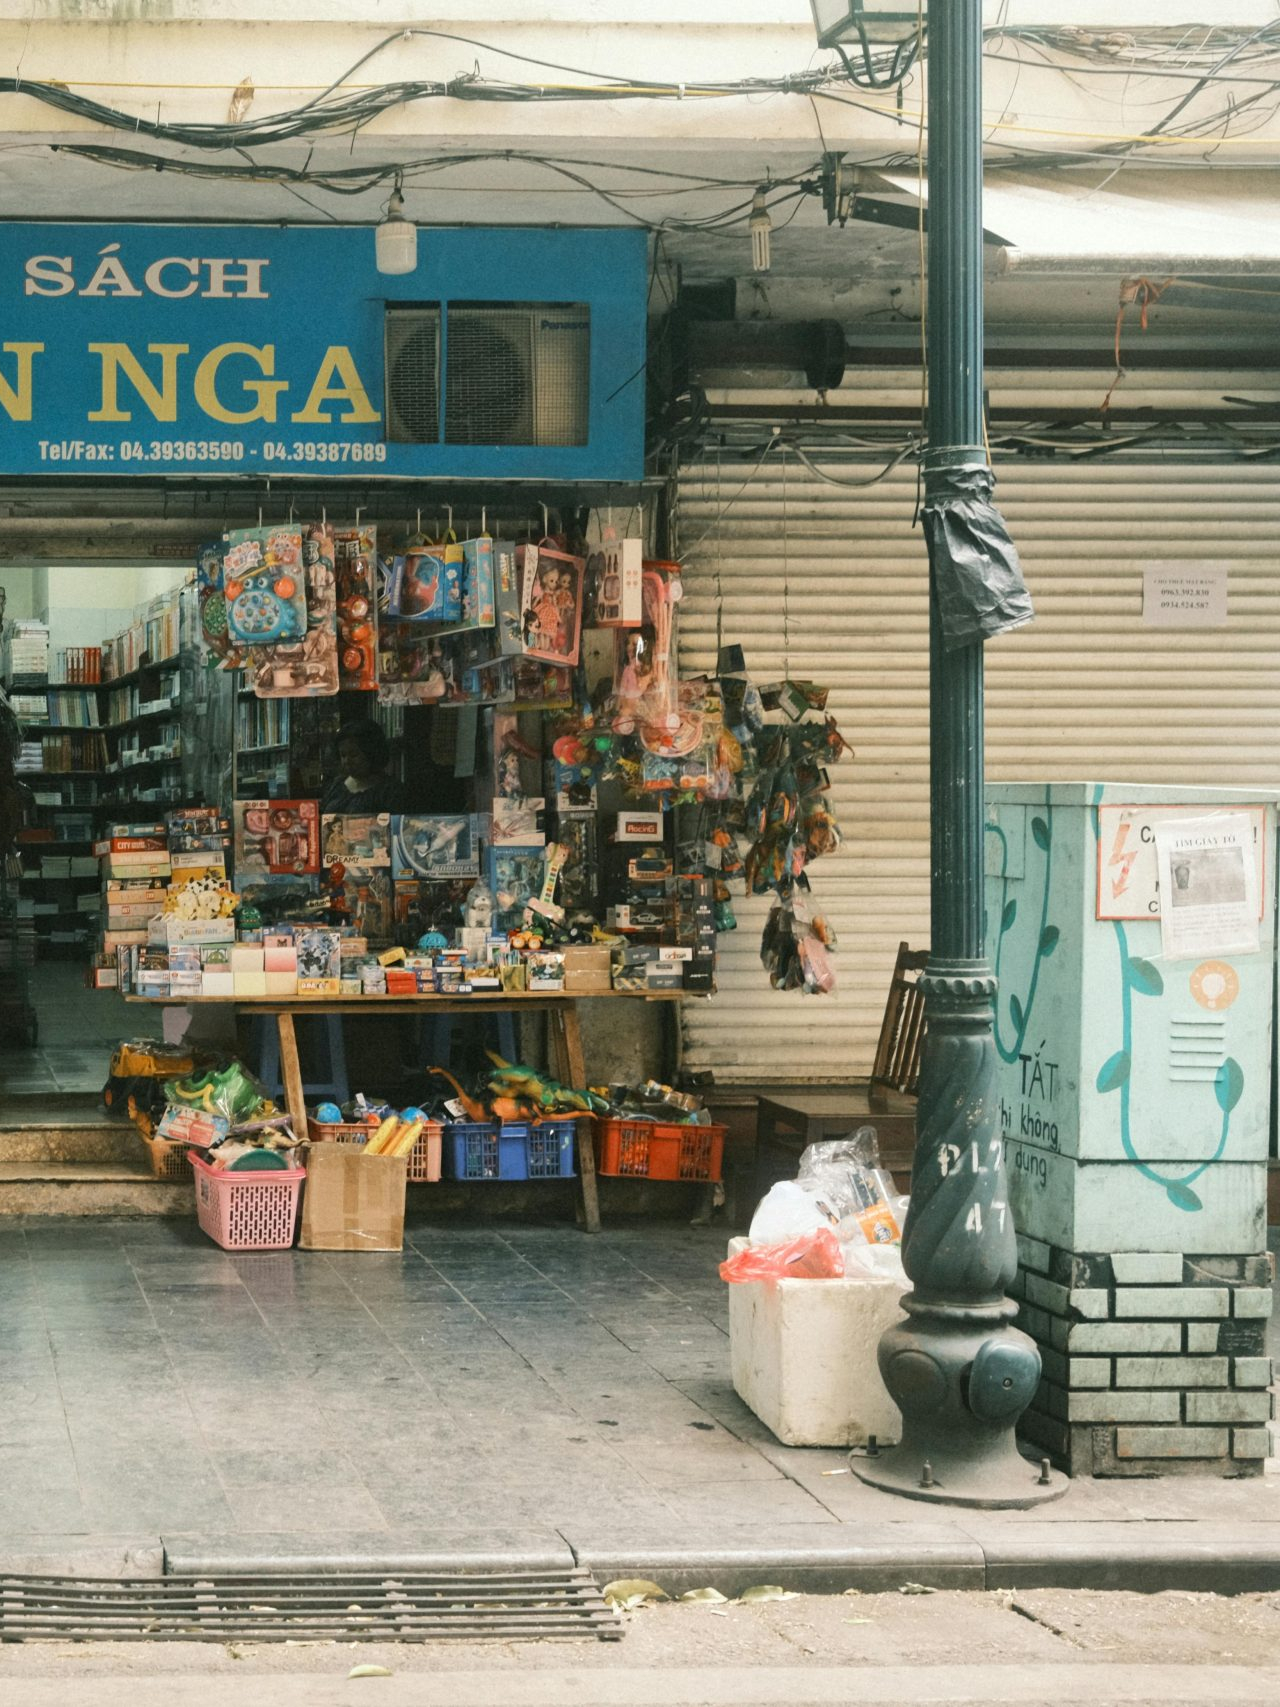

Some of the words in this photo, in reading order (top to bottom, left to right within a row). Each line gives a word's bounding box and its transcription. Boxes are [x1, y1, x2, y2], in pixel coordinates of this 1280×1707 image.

[24, 242, 270, 299] SÁCH
[87, 341, 382, 425] NGA
[38, 440, 115, 461] Tel/Fax:
[119, 441, 244, 461] 04.39363590
[263, 441, 387, 463] 04.39387689
[1018, 1039, 1059, 1102] TẮT
